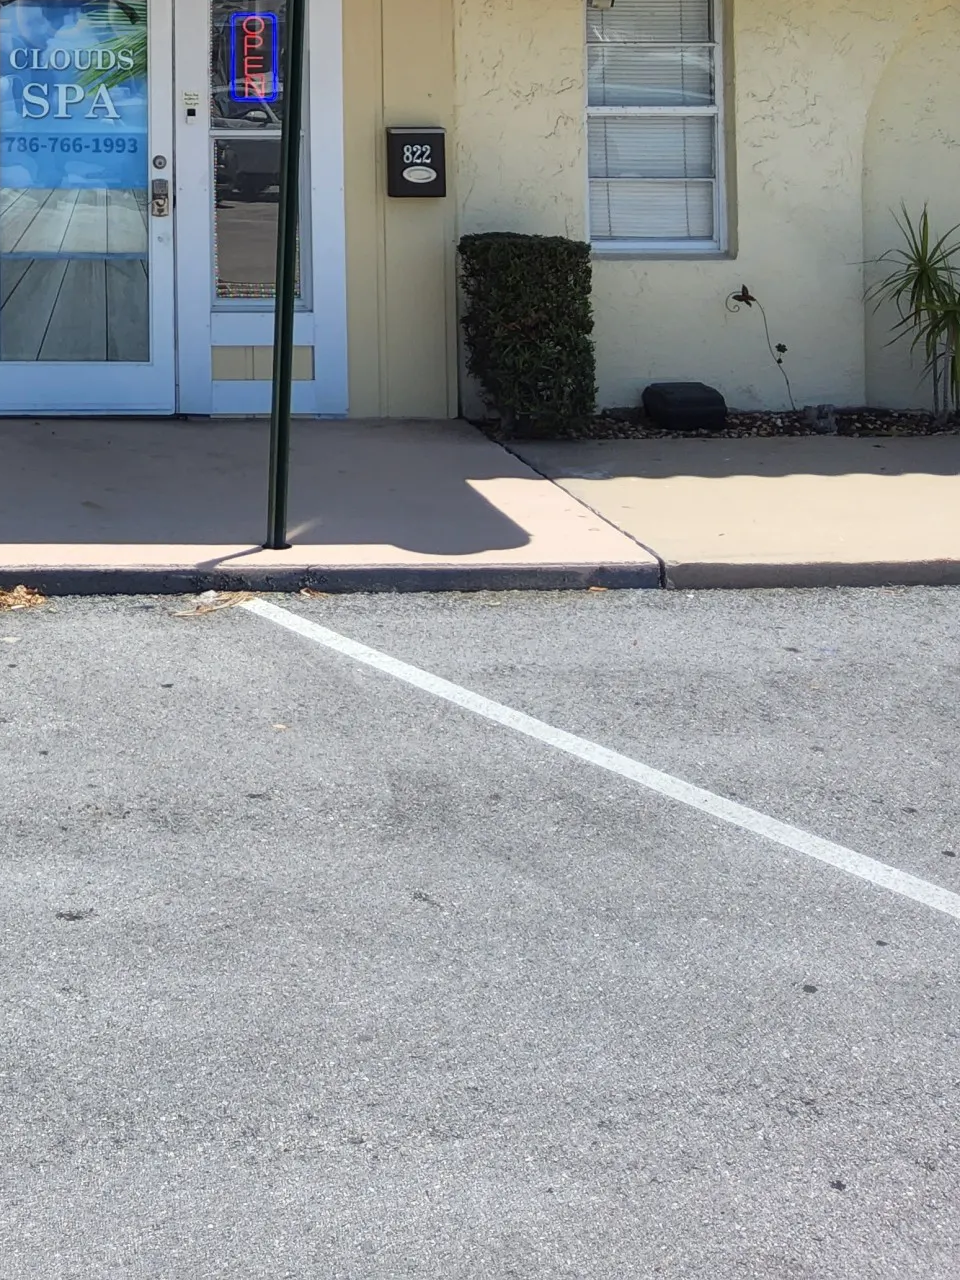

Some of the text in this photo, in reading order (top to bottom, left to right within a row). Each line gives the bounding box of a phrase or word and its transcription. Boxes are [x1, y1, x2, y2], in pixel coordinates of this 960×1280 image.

[9, 47, 135, 70] CLOUDS
[242, 15, 266, 99] OPEN
[22, 82, 122, 120] SPA
[4, 136, 139, 154] 786-766-1993
[403, 144, 432, 164] 822
